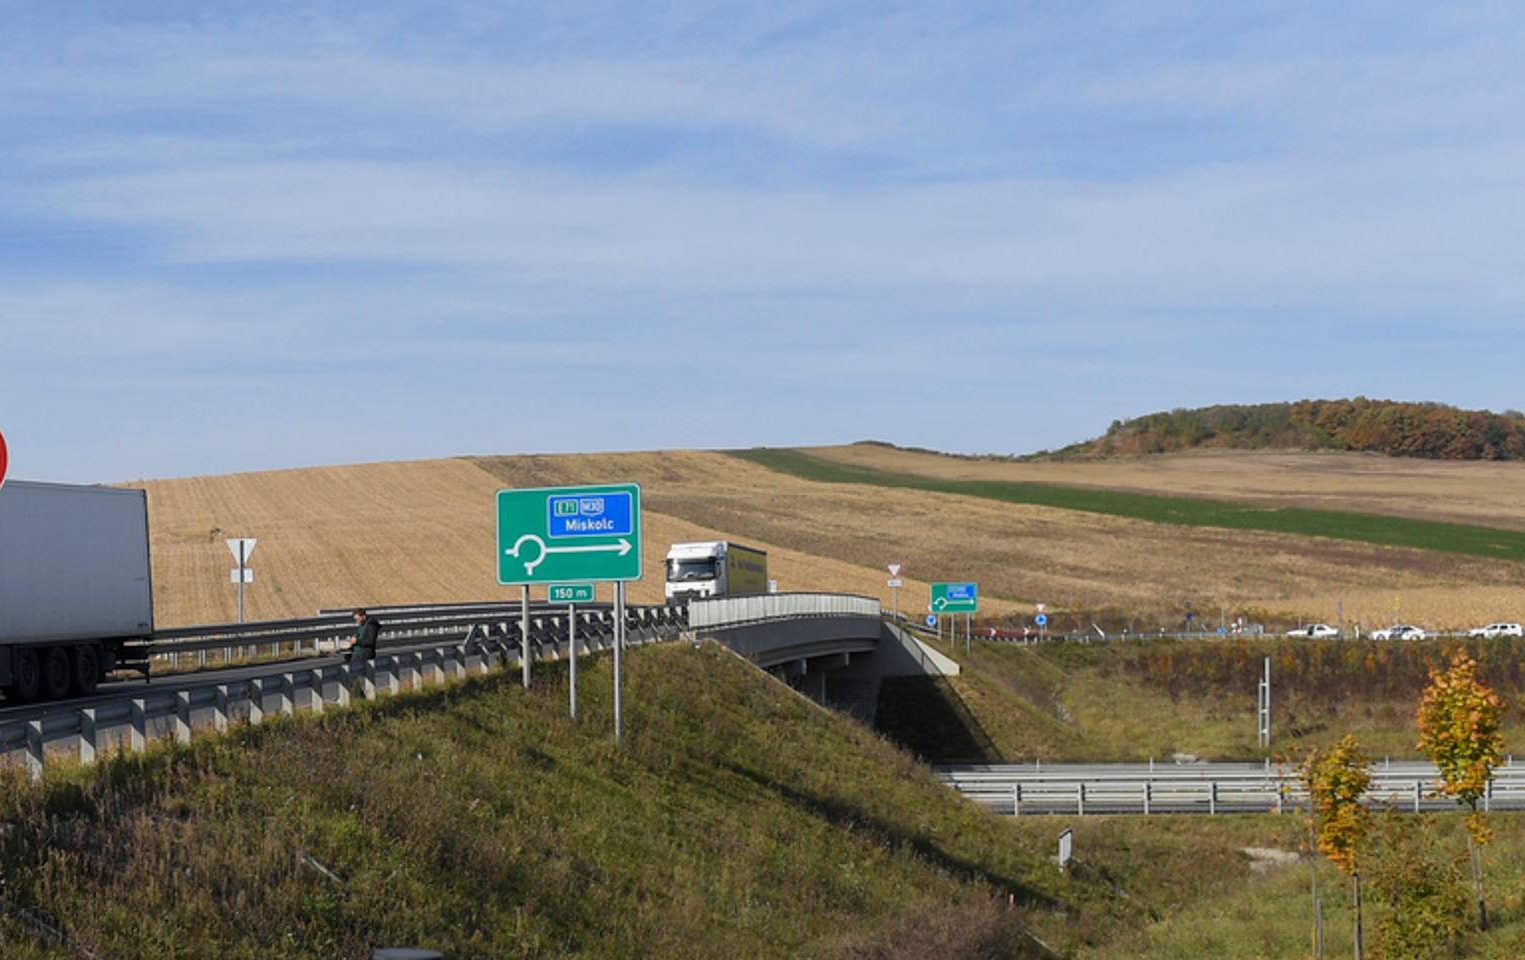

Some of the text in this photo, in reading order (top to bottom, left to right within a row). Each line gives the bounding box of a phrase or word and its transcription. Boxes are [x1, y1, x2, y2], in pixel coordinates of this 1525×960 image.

[565, 518, 614, 531] Miskolc
[555, 588, 587, 599] 150 m
